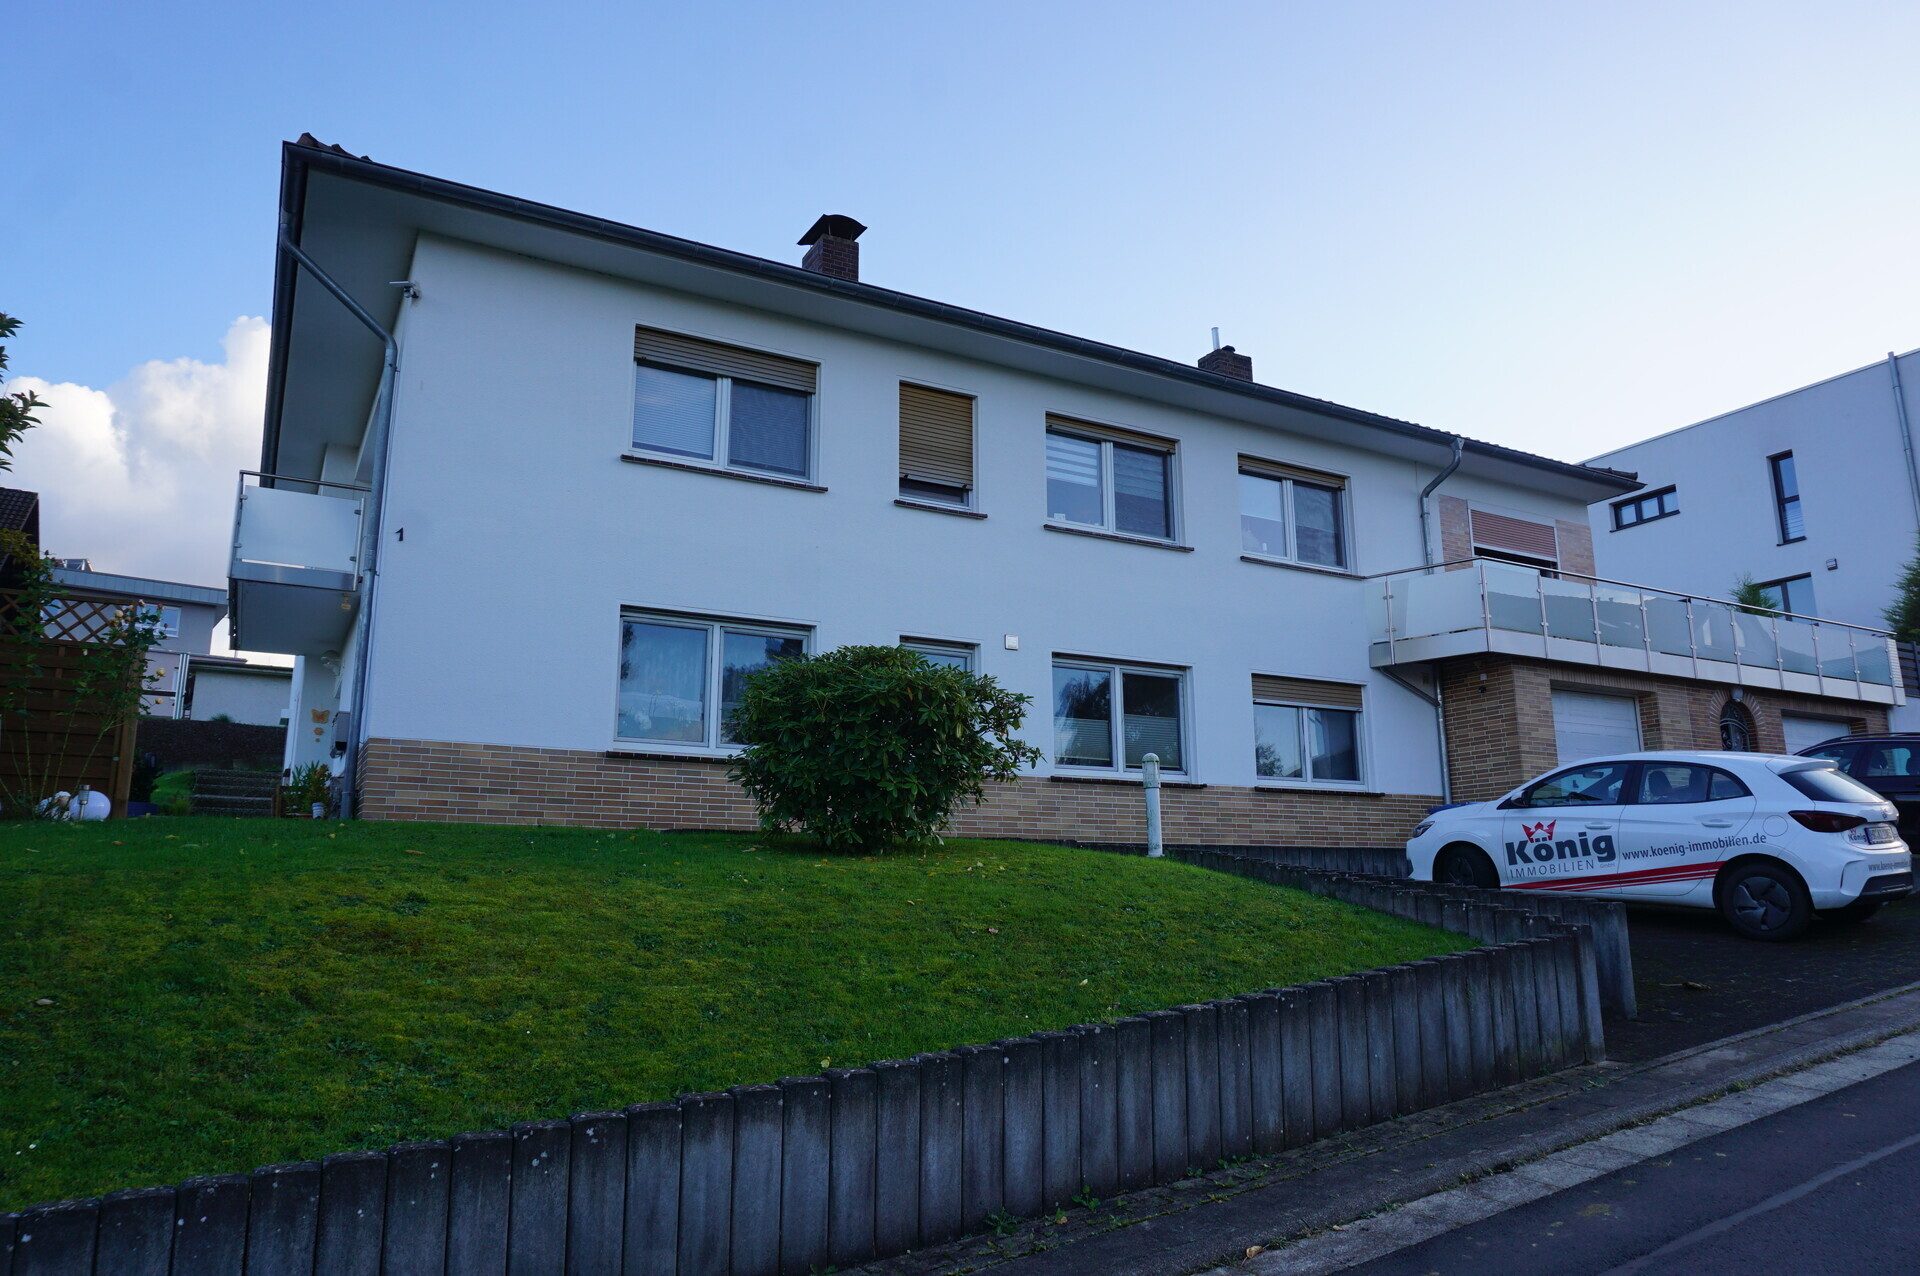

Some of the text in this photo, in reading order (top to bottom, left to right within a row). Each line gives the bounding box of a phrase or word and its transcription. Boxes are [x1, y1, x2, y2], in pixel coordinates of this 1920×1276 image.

[395, 527, 403, 541] 1
[1505, 831, 1617, 866] König
[1622, 833, 1767, 860] www.koenig-immobilien.de
[1509, 859, 1595, 879] IMMOBILIEN
